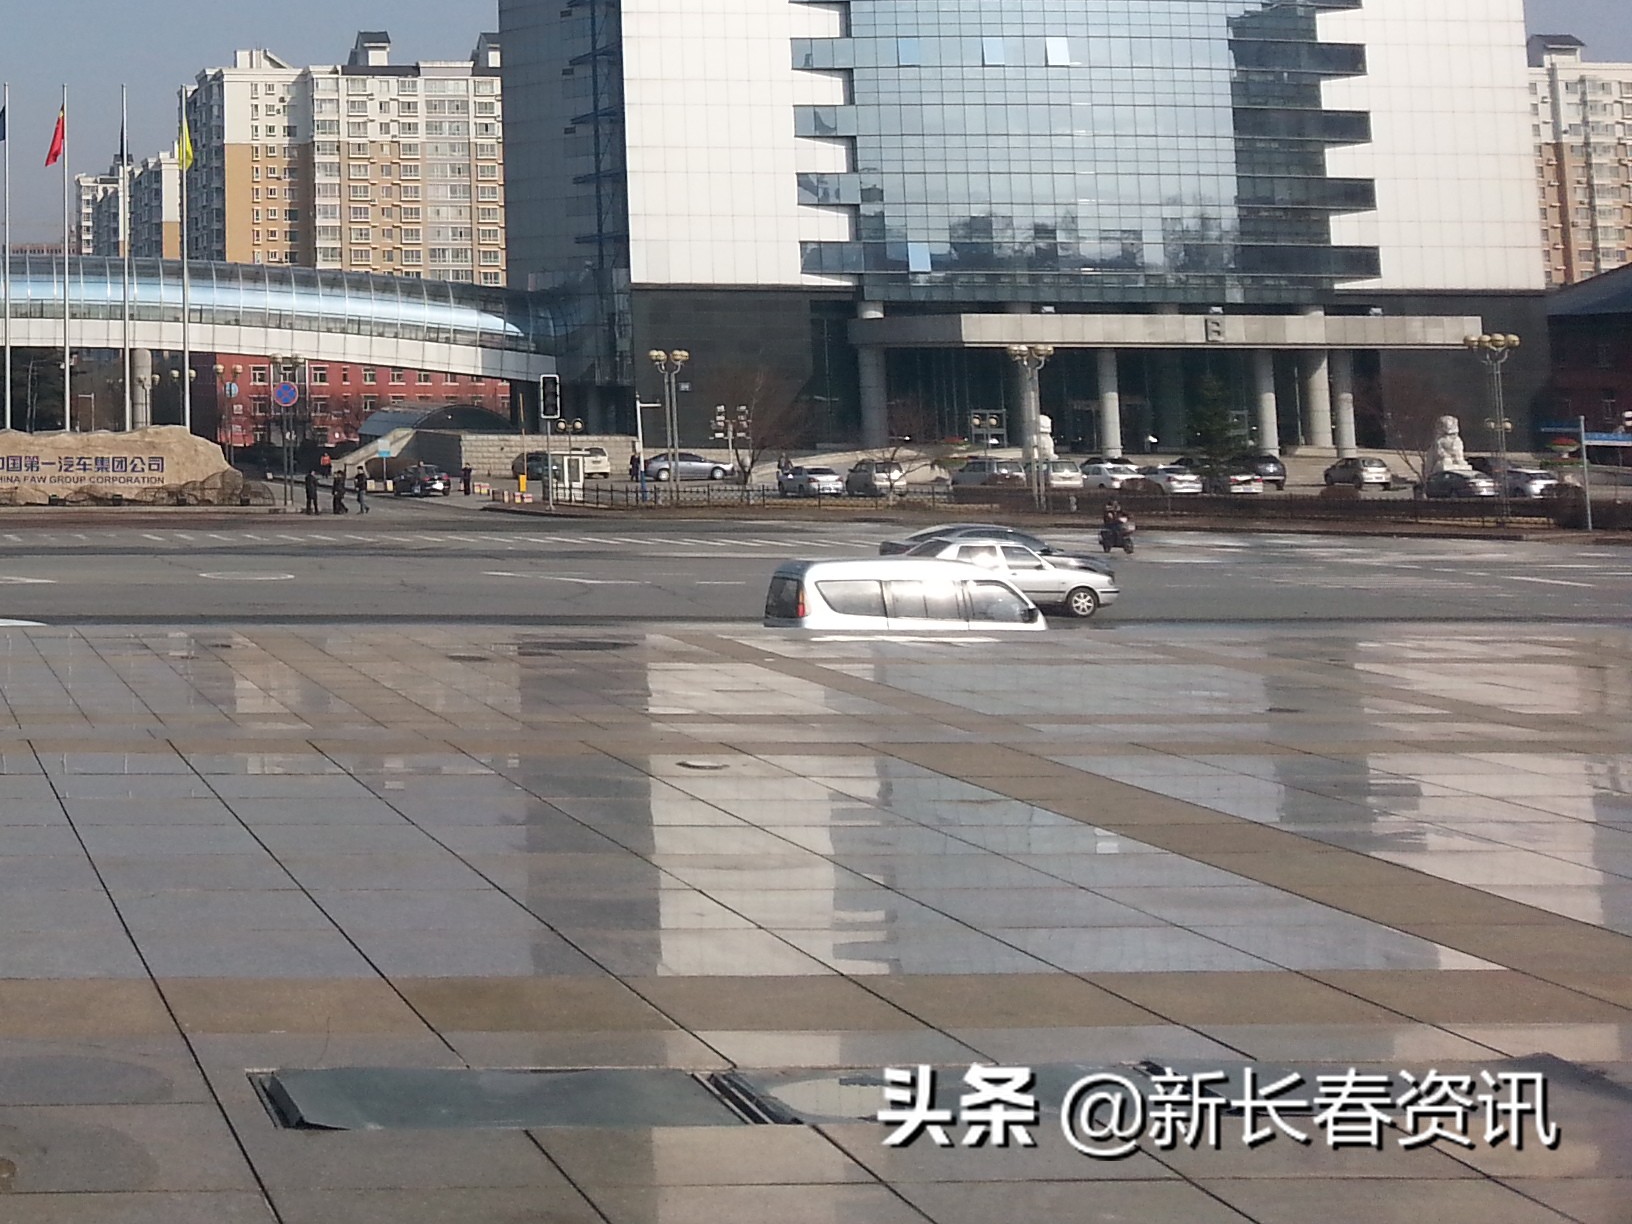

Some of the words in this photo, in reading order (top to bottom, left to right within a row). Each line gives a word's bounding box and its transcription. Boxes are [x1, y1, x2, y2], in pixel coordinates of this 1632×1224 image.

[23, 475, 47, 484] FAW
[49, 475, 86, 484] GROUP
[89, 475, 165, 484] CORPORATION
